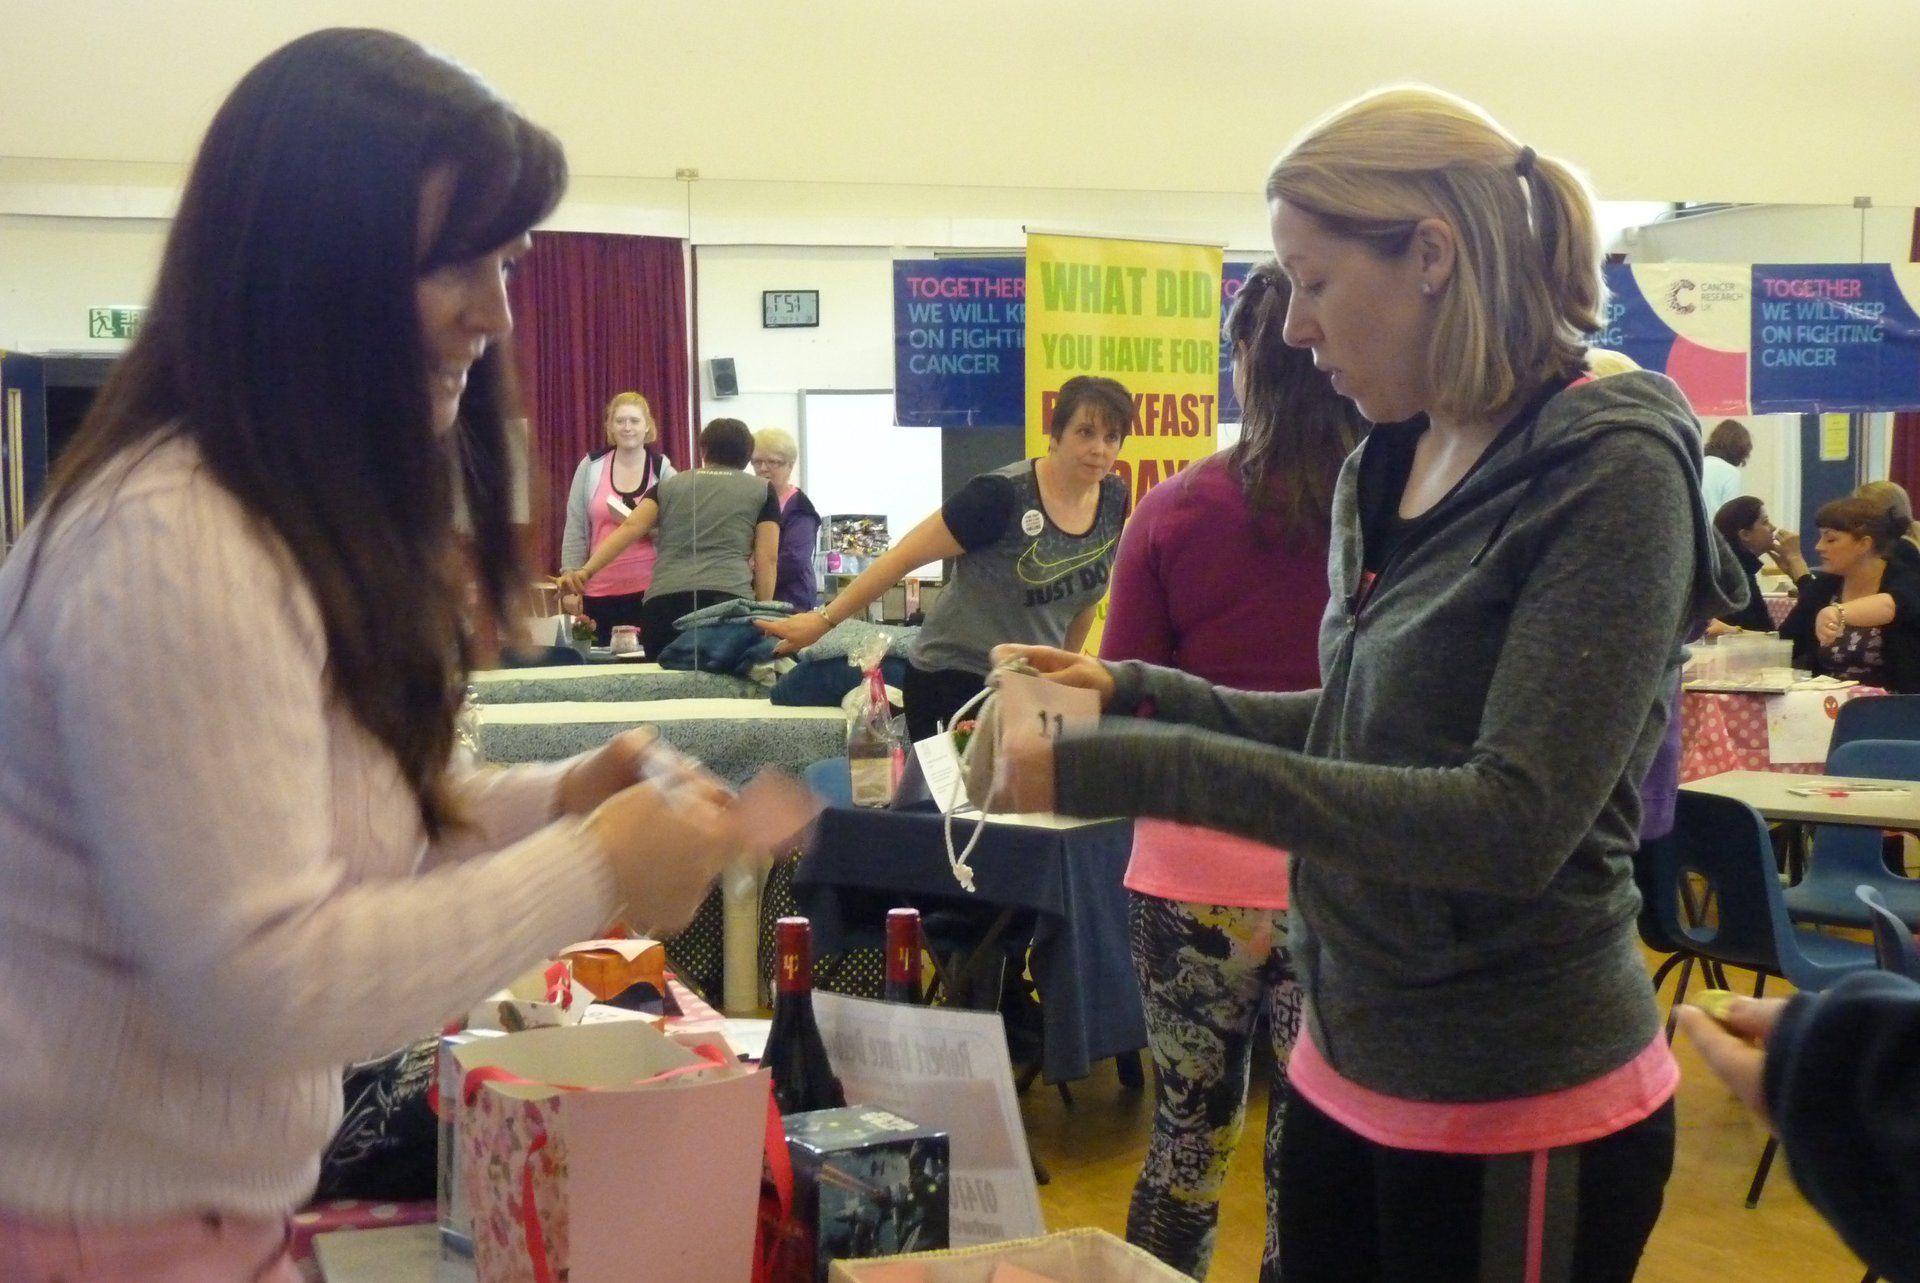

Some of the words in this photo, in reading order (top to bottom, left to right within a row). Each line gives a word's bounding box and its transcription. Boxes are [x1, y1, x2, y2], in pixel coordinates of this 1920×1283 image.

[907, 277, 1026, 298] TOGETHER
[1040, 261, 1148, 317] WHAT
[1156, 270, 1213, 319] DID
[1700, 282, 1736, 292] CANCER
[1700, 293, 1744, 302] RESEARCH
[1762, 279, 1862, 298] TOGETHER
[908, 303, 943, 324] WE
[949, 304, 1001, 324] WILL
[1762, 303, 1793, 321] WE
[1797, 302, 1839, 321] WILL
[1844, 302, 1886, 321] KEEP
[908, 329, 945, 350] ON
[1762, 325, 1792, 344] ON
[1796, 325, 1885, 344] FIGHTING
[908, 354, 1000, 375] CANCER
[1041, 333, 1093, 371] YOU
[1100, 335, 1164, 374] HAVE
[1170, 339, 1214, 375] FOR
[1761, 349, 1837, 368] CANCER
[1023, 574, 1075, 608] JUST
